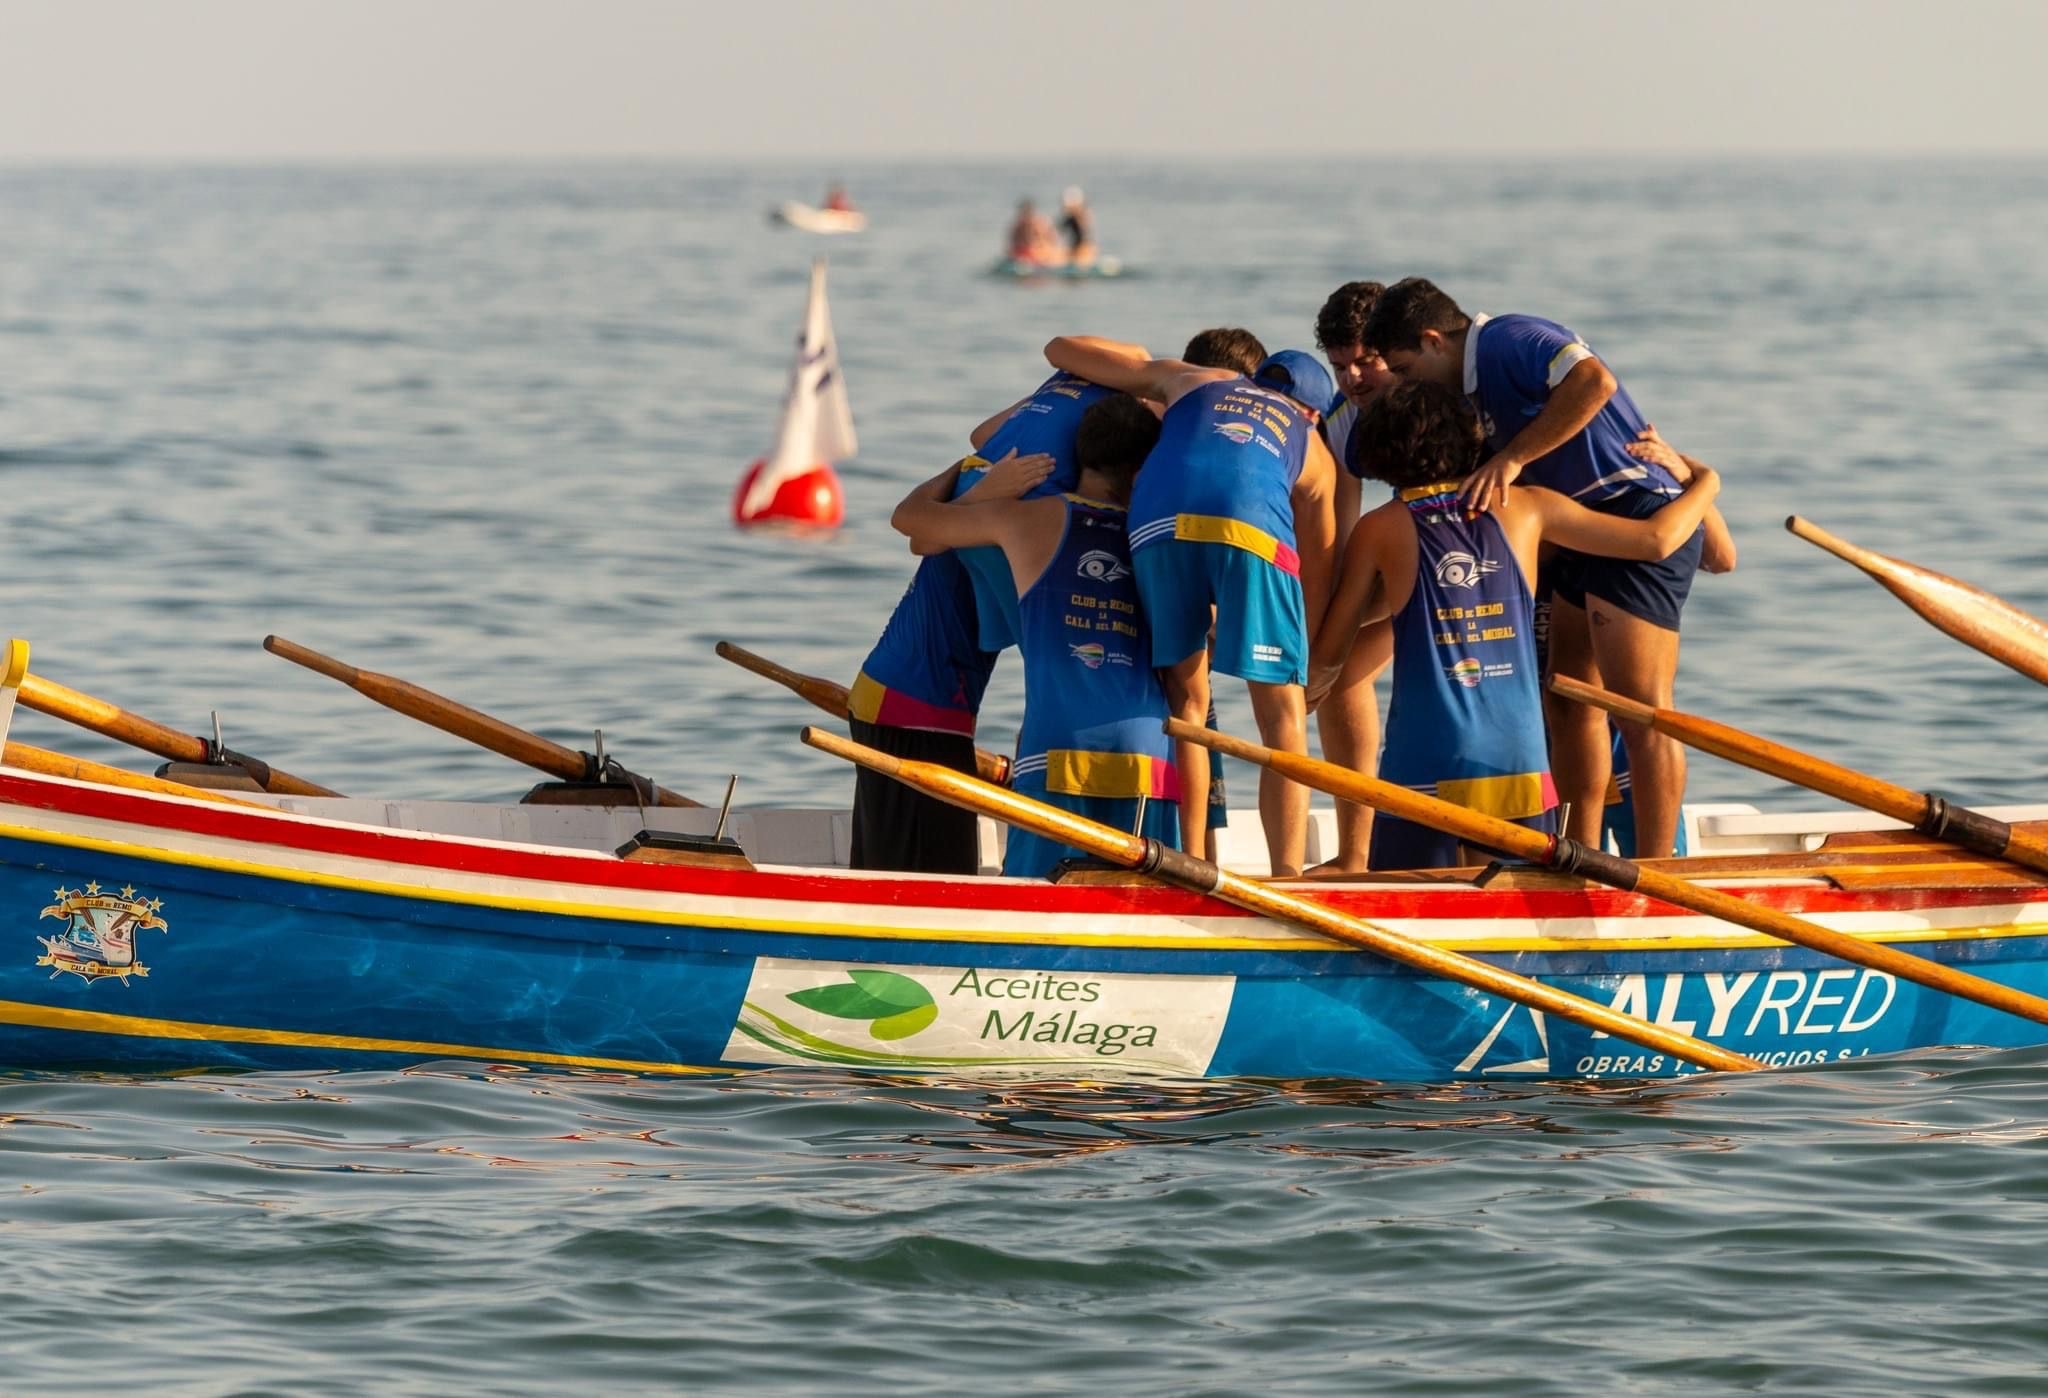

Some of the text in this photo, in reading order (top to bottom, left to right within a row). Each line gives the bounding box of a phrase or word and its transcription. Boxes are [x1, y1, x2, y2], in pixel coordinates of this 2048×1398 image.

[1214, 404, 1243, 414] CALA
[1266, 405, 1291, 427] REMO
[1071, 594, 1096, 608] CLUB
[1437, 607, 1464, 620] CLUB
[1475, 602, 1504, 618] REMO
[1065, 614, 1091, 629] CALA
[1467, 621, 1477, 631] LA
[1482, 626, 1516, 641] MORAL
[86, 899, 104, 907] CLUB
[113, 902, 133, 911] REMO
[71, 964, 86, 972] CALA
[950, 968, 1100, 1002] Aceites
[980, 1010, 1158, 1056] Málaga
[1576, 1055, 1665, 1073] OBRAS
